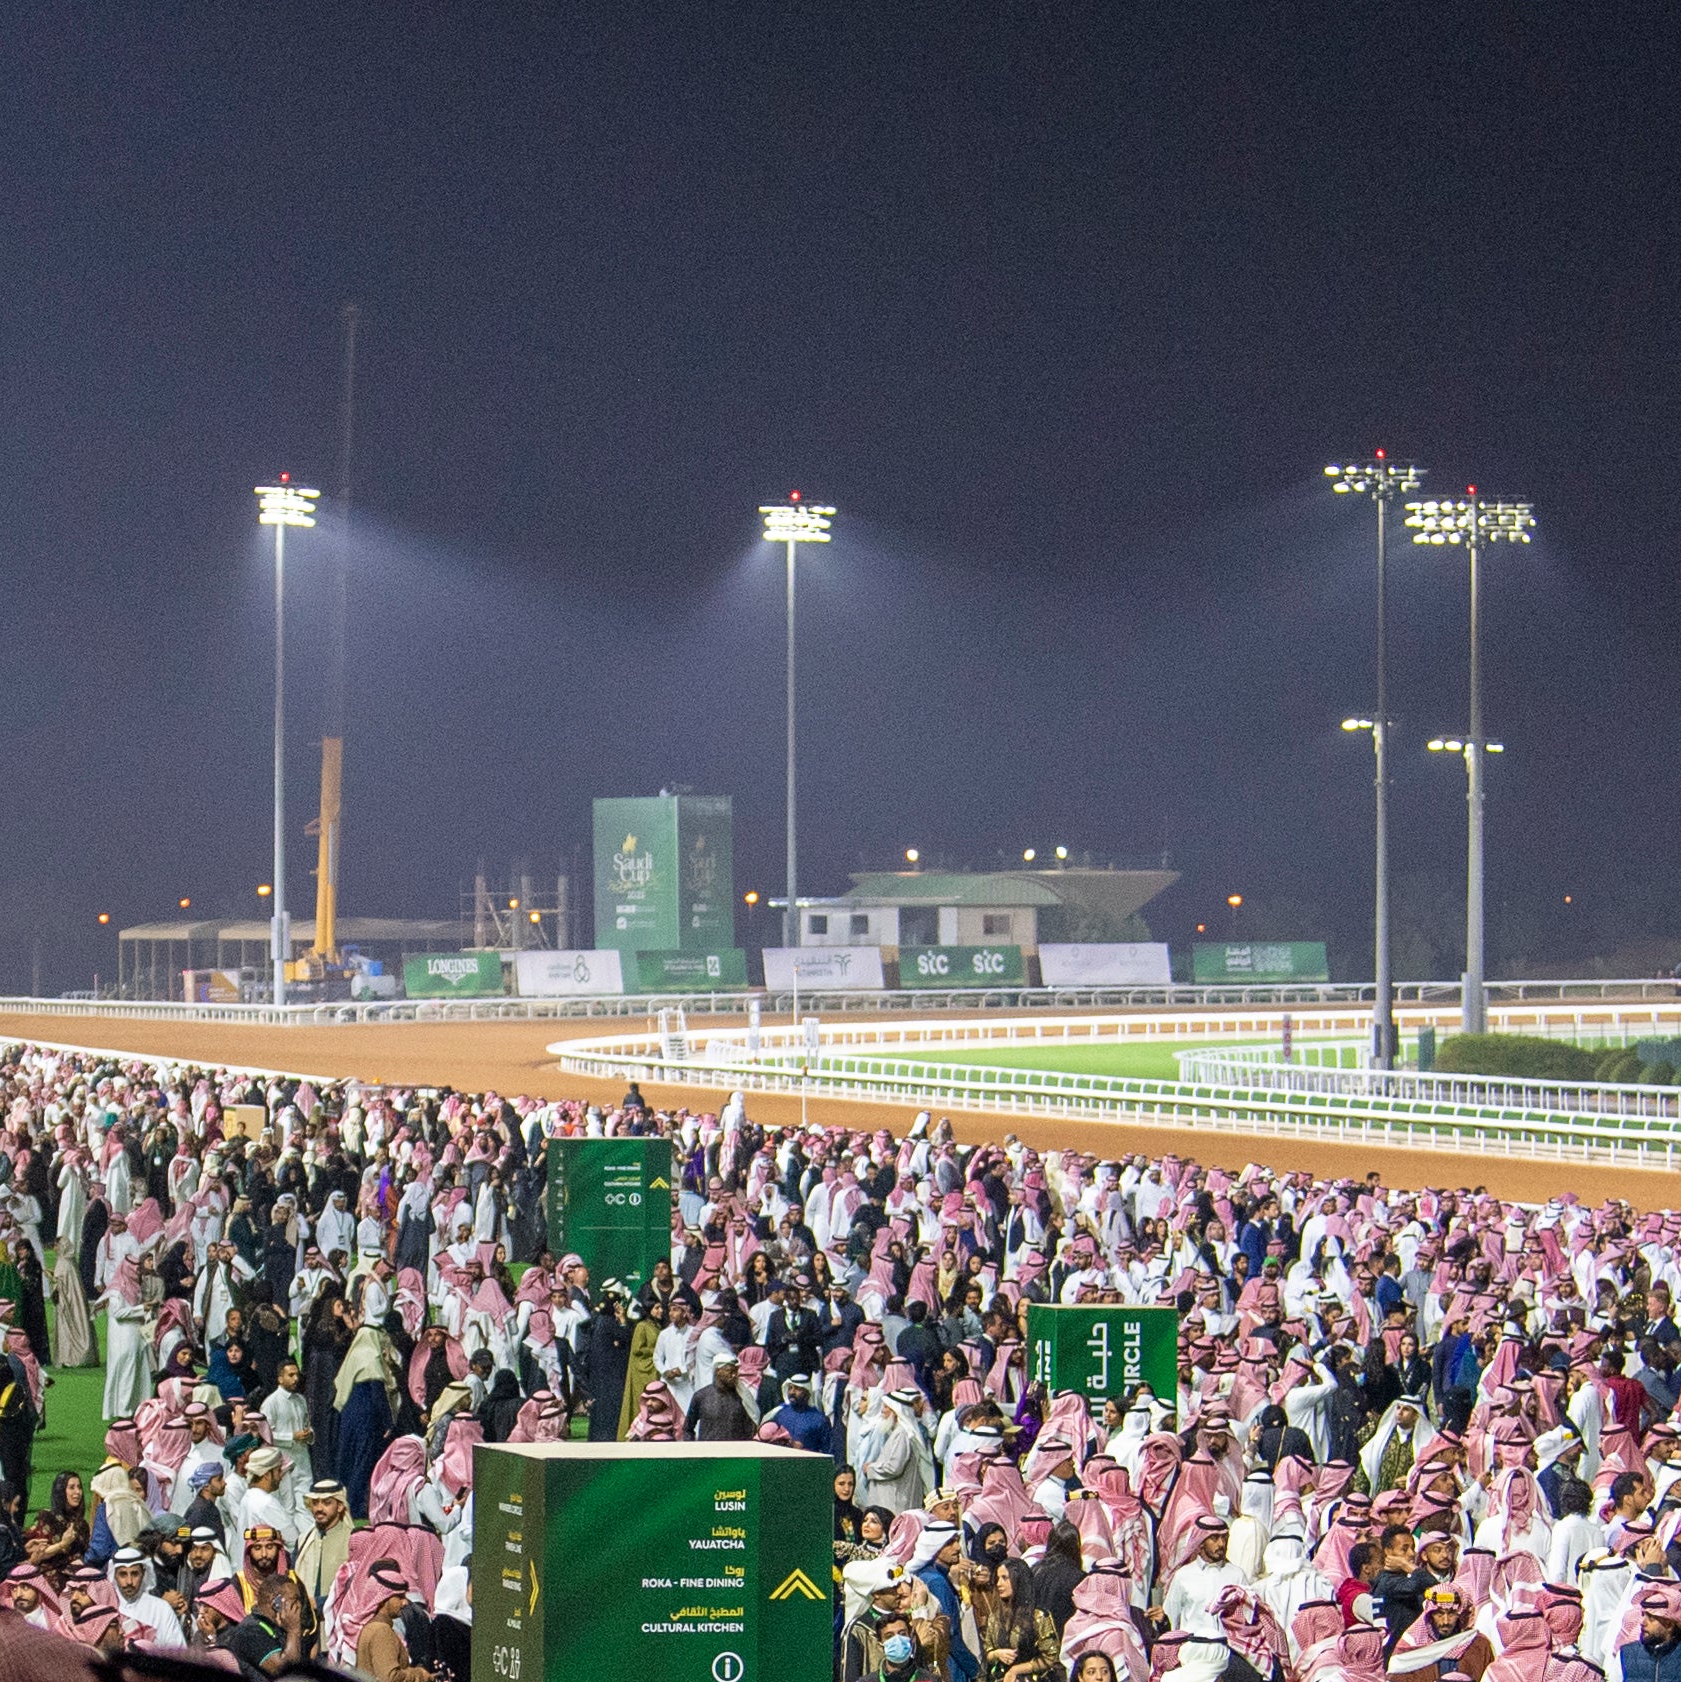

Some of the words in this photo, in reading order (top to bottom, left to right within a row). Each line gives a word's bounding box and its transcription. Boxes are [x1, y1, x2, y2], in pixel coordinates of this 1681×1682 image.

[427, 958, 478, 974] LONGINES
[918, 950, 949, 975] stc
[973, 950, 1005, 974] stc
[1086, 1322, 1113, 1390] حلبة
[714, 1489, 746, 1500] لوسين
[714, 1501, 746, 1511] LUSIN
[688, 1540, 745, 1549] YAUATCHA
[641, 1578, 672, 1588] ROKA
[680, 1578, 704, 1588] FINE
[705, 1578, 745, 1588] DINING
[670, 1605, 708, 1620] الثقافي
[709, 1606, 744, 1619] المطبخ
[641, 1623, 696, 1633] CULTURAL
[697, 1623, 744, 1632] KITCHEN
